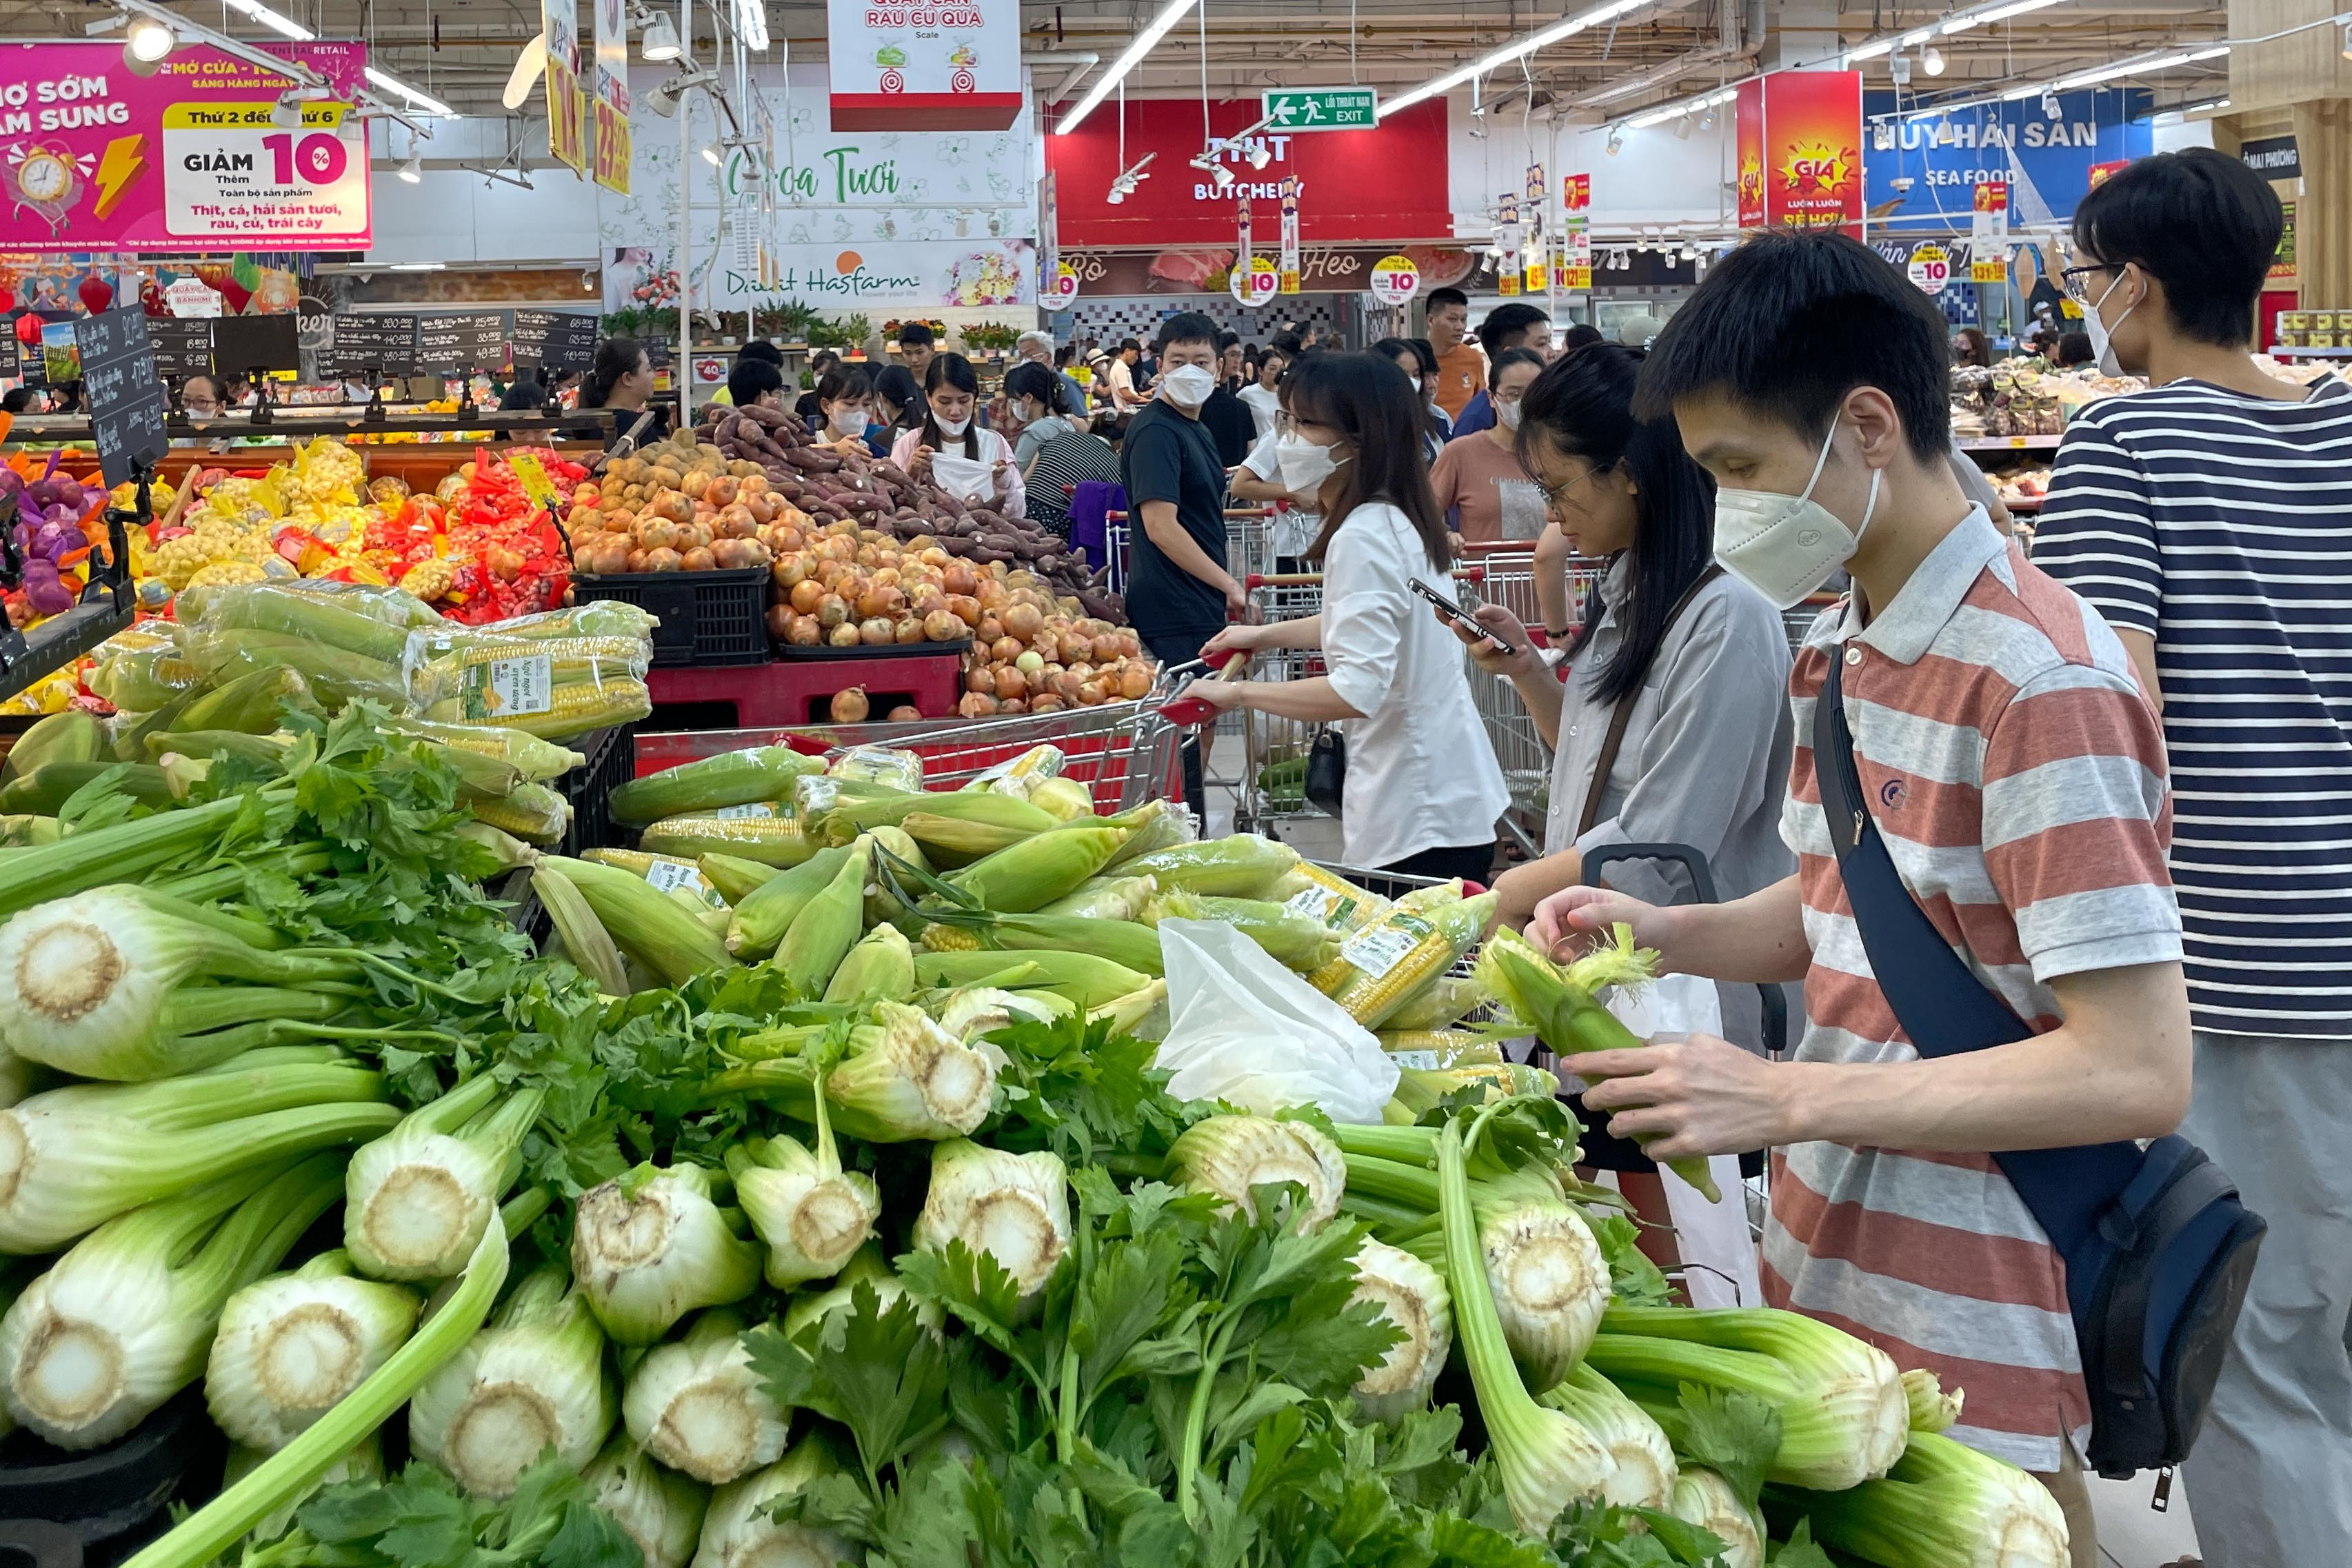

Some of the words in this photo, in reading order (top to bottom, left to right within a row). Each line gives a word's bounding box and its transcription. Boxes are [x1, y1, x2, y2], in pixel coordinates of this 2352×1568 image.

[867, 12, 905, 26] RAU
[910, 7, 936, 26] CỦ
[941, 7, 981, 26] QUẢ
[915, 31, 939, 39] Scale
[314, 46, 350, 54] RETAIL
[172, 59, 199, 74] MỞ
[203, 59, 238, 74] CỬA
[192, 77, 225, 88] SÁNG
[227, 77, 261, 88] HÀNG
[262, 77, 295, 88] NGÀY
[0, 81, 28, 110] Ợ
[37, 74, 108, 104] SỚM
[39, 101, 130, 132] SUNG
[188, 110, 224, 123] Thứ
[228, 112, 239, 123] 2
[322, 111, 334, 123] 6
[1336, 110, 1363, 122] EXIT
[183, 148, 254, 172] GIẢM
[2249, 153, 2264, 170] MAI
[823, 146, 900, 203] Tươi
[1793, 157, 1837, 181] GIÁ
[215, 174, 250, 184] Thêm
[1924, 170, 1960, 187] SEA
[1963, 169, 2018, 187] FOOD
[219, 188, 245, 197] Toàn
[247, 189, 261, 199] bộ
[263, 188, 281, 197] sản
[283, 186, 312, 198] phẩm
[1194, 181, 1305, 200] BUTCHEY
[191, 204, 225, 219] Thịt,
[228, 203, 250, 217] cá,
[253, 203, 275, 214] hải
[279, 203, 305, 214] sản
[308, 203, 342, 216] tươi,
[1787, 198, 1814, 208] LUÔN
[1816, 198, 1842, 208] LUÔN
[210, 219, 239, 230] rau,
[243, 217, 264, 230] củ,
[268, 217, 293, 228] trái
[297, 217, 323, 230] cây
[1300, 250, 1362, 281] Heo
[1923, 261, 1947, 280] 10
[806, 266, 920, 296] Hasfarm
[1389, 272, 1414, 290] 10
